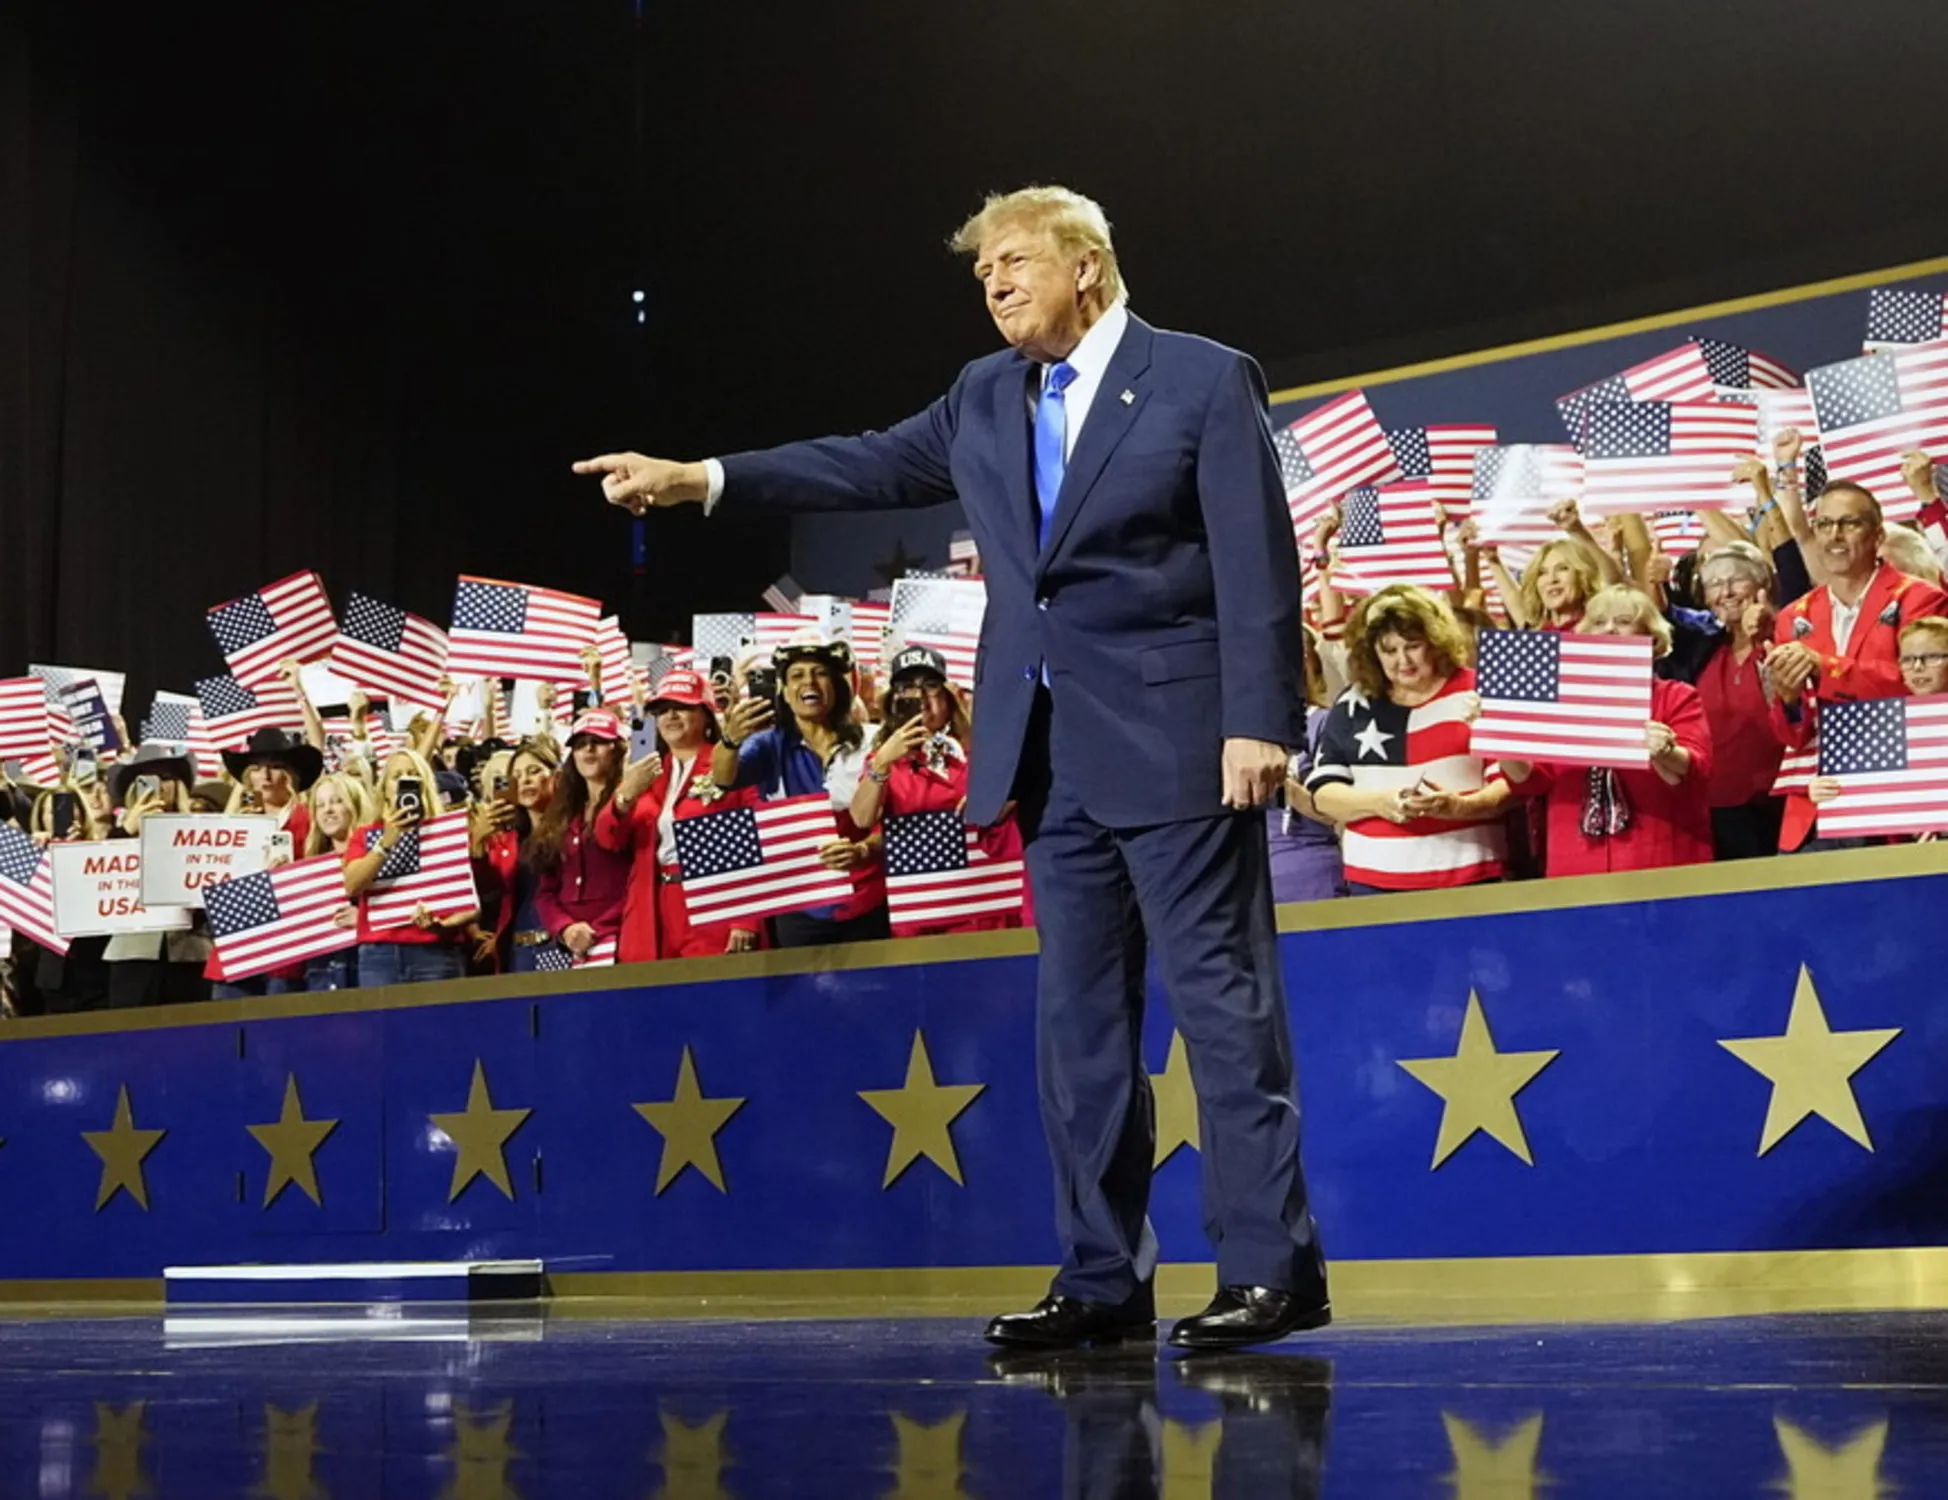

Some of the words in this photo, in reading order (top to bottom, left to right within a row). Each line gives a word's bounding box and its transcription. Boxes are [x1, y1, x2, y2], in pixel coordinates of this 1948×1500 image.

[900, 651, 936, 668] USA
[173, 829, 249, 847] MADE
[84, 854, 140, 874] MAD
[185, 854, 201, 864] IN
[205, 854, 233, 865] THE
[98, 880, 112, 891] IN
[98, 896, 146, 916] USA
